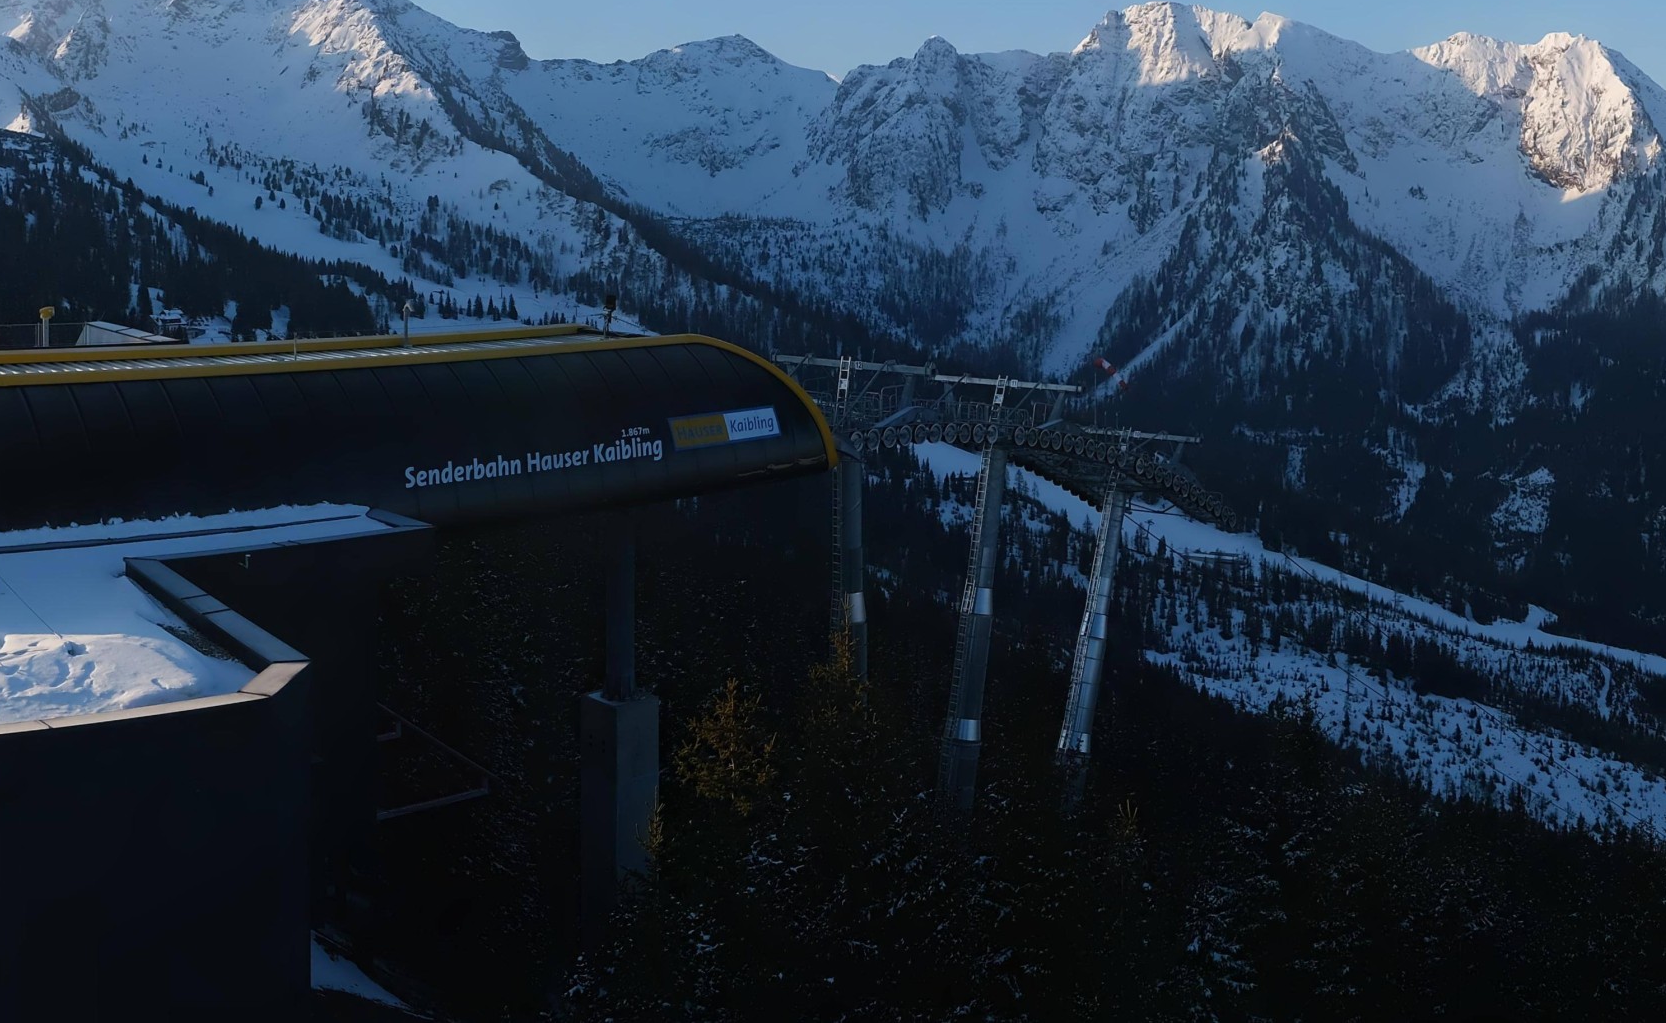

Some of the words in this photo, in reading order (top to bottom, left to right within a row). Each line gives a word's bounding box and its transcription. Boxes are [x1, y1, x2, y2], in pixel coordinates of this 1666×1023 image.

[730, 415, 775, 433] Kaibling
[404, 455, 521, 488] Senderbahn
[527, 449, 589, 473] Hauser
[593, 437, 663, 463] Kaibling
